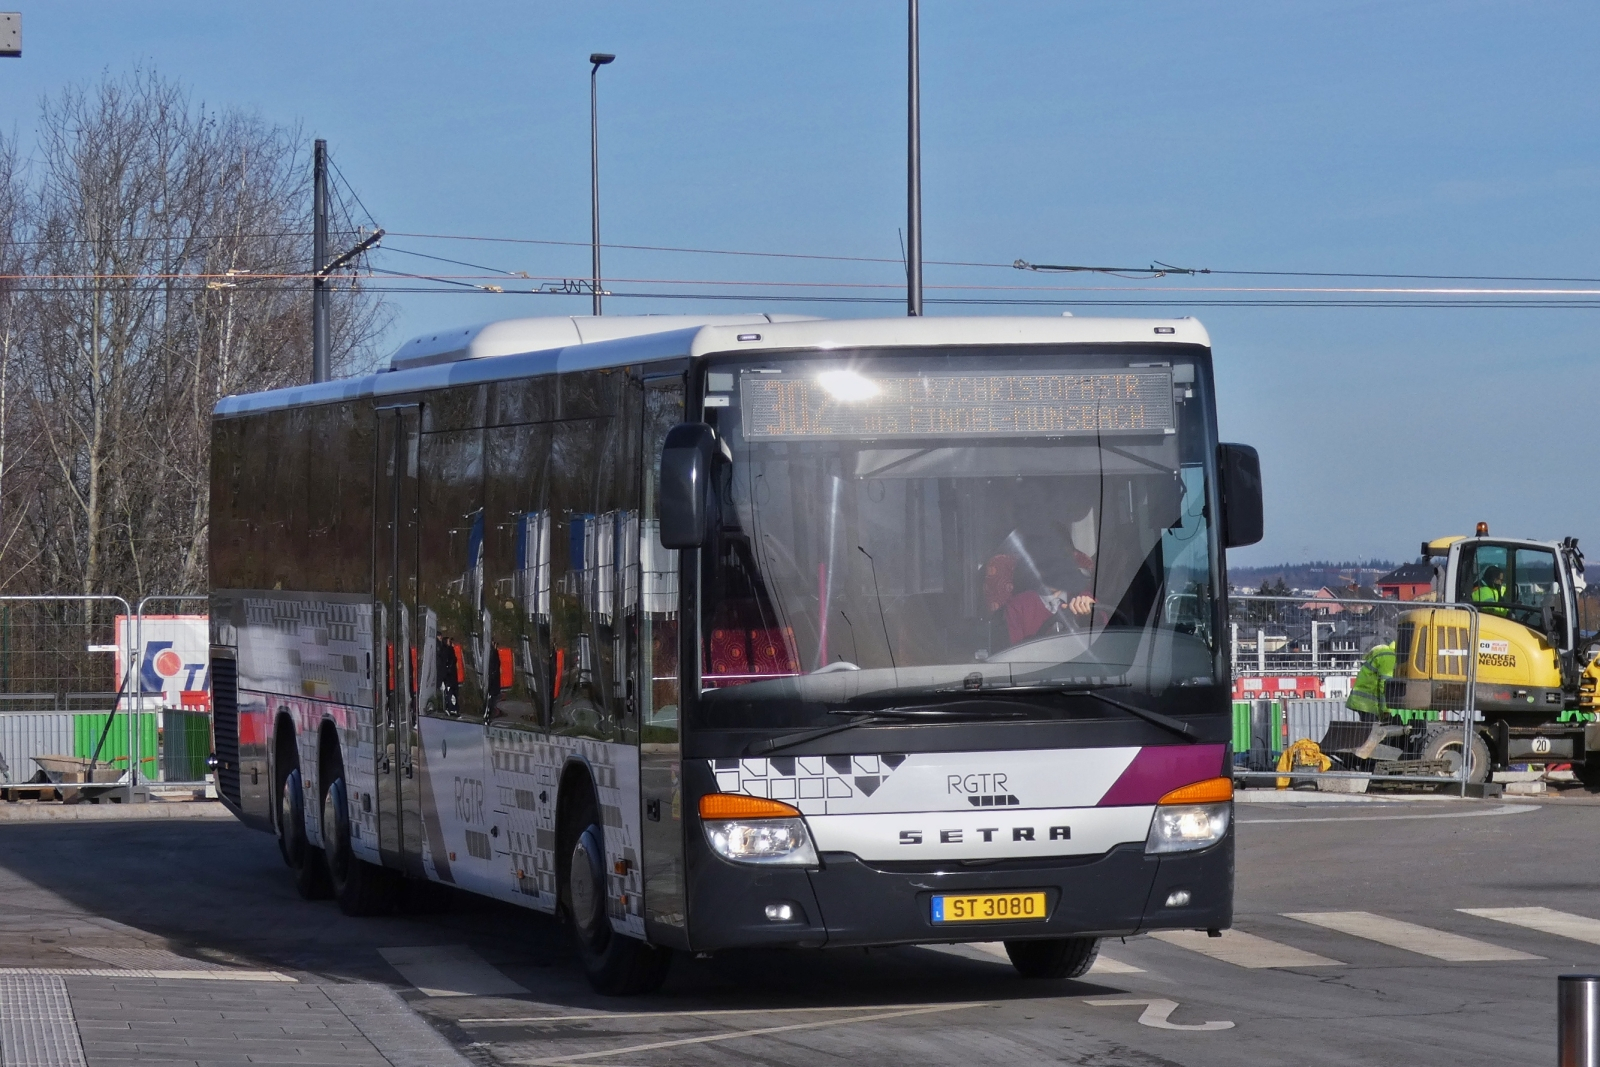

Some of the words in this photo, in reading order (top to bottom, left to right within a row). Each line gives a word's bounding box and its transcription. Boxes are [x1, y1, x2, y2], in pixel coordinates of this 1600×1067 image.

[764, 380, 833, 434] 302
[1479, 653, 1515, 662] WACKER
[1479, 659, 1515, 667] NEUSON
[1536, 739, 1547, 752] 20
[948, 772, 1008, 795] RGTR
[455, 776, 485, 825] RGTR
[899, 826, 1071, 845] SETRA
[953, 898, 978, 918] ST
[983, 896, 1034, 917] 3080
